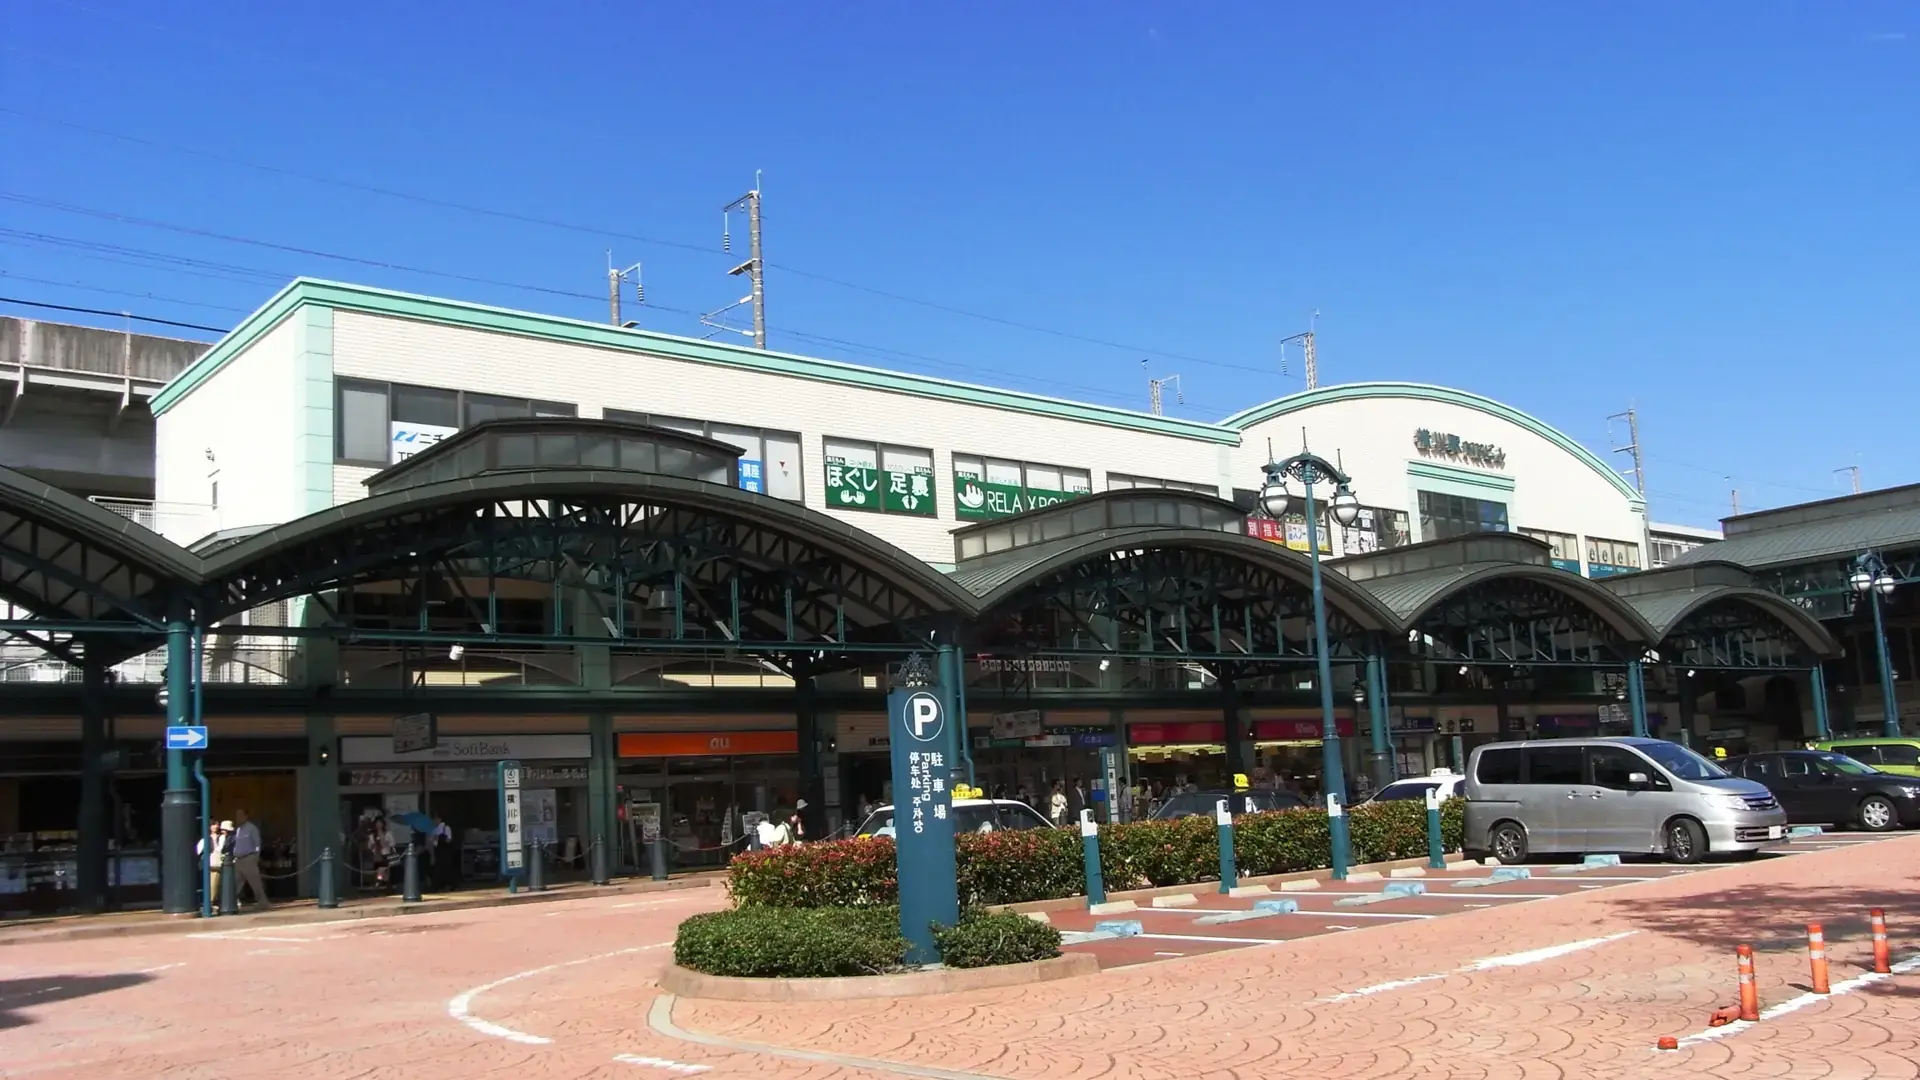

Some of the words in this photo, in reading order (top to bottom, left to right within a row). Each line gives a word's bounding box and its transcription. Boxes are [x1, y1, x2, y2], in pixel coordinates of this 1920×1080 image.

[826, 465, 878, 491] ほぐし
[890, 472, 929, 497] 足裏
[913, 698, 938, 736] P
[453, 741, 511, 757] SoftBank
[710, 737, 730, 749] au
[909, 751, 922, 789] 停车处
[921, 753, 932, 802] Parking
[931, 752, 946, 820] 駐車場
